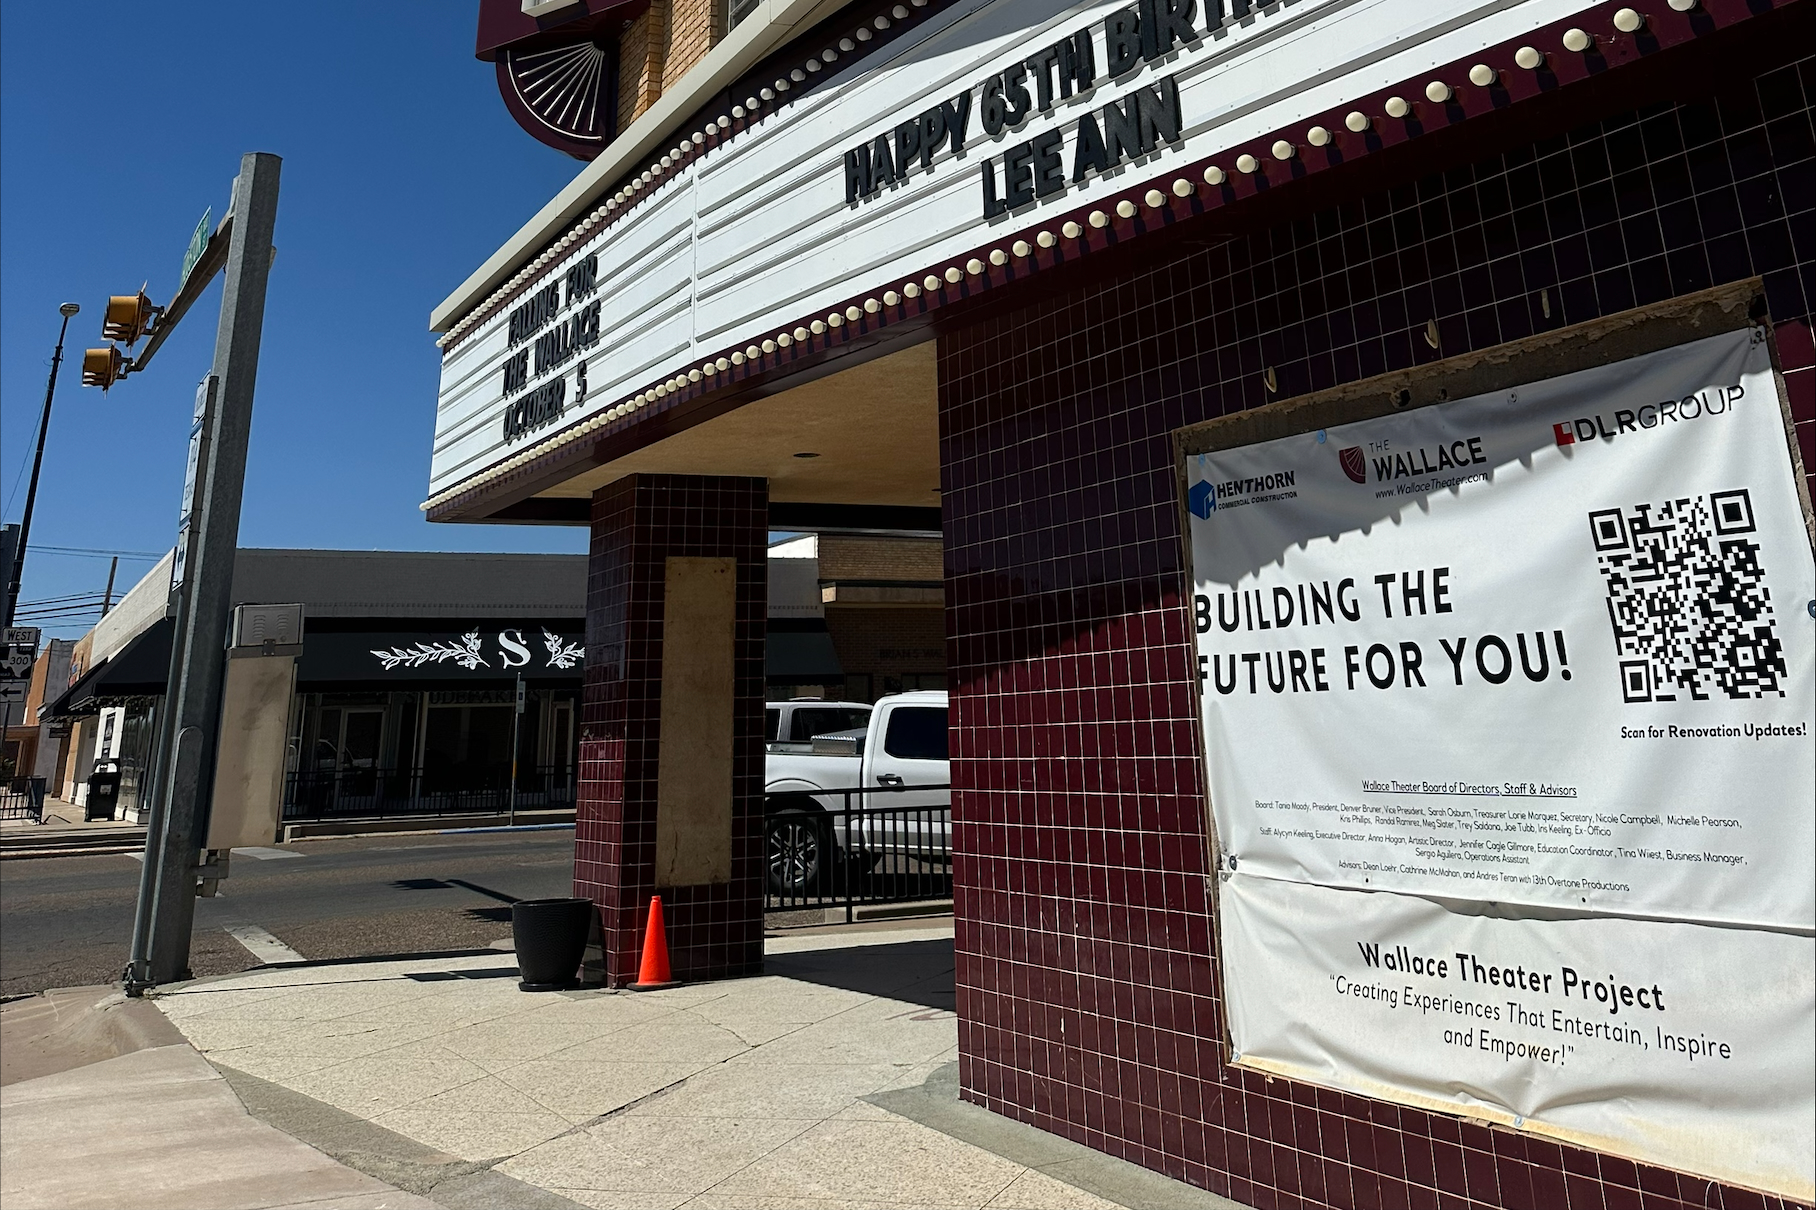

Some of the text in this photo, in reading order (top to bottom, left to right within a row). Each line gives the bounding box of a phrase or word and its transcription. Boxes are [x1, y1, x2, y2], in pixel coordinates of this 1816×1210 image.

[845, 89, 973, 203] HAPPY
[980, 27, 1096, 137] 65TH
[980, 75, 1182, 221] LEE ANN
[507, 252, 598, 347] FALLING FOR
[502, 299, 601, 396] THE WALLACE
[503, 375, 566, 440] OCTOBER
[1369, 440, 1391, 453] THE
[1372, 436, 1487, 482] WALLACE
[1216, 470, 1295, 499] HENTHORN
[1218, 491, 1298, 511] COMMERCIAL CONSTRUCTION
[1375, 471, 1489, 500] www.WallaceTheater.com
[1195, 566, 1453, 634] BUILDING THE
[7, 630, 32, 641] WEST
[498, 628, 532, 670] S
[10, 656, 29, 665] 300
[1198, 630, 1572, 696] FUTURE FOR YOU!
[1621, 722, 1807, 741] Scan for Renovation Updates!
[1361, 780, 1577, 795] Wallace Theater Board of Directors, Staff & Advisors
[1255, 800, 1274, 809] Board:
[1274, 801, 1291, 810] Tania
[1340, 803, 1362, 813] Denver
[1384, 805, 1397, 814] Vice
[1427, 807, 1446, 817] Sarah
[1473, 809, 1507, 819] Treasurer
[1508, 810, 1526, 820] Lorie
[1527, 811, 1560, 822] Marquez,
[1560, 812, 1595, 825] Secretary,
[1595, 814, 1618, 823] Nicole
[1619, 813, 1663, 827] Campbell,
[1667, 815, 1700, 826] Michelle
[1701, 816, 1742, 828] Pearson,
[1339, 814, 1351, 823] Kris
[1396, 817, 1422, 827] Ramirez,
[1422, 819, 1436, 830] Meg
[1457, 820, 1473, 832] Trey
[1473, 821, 1503, 832] Saldana,
[1504, 822, 1517, 832] Joe
[1517, 823, 1537, 833] Tubb,
[1549, 824, 1574, 836] Keeling,
[1273, 828, 1293, 839] Alycyn
[1315, 830, 1341, 840] Executive
[1341, 832, 1367, 842] Director,
[1367, 833, 1383, 843] Anna
[1384, 834, 1407, 846] Hogan,
[1408, 835, 1429, 845] Artistic
[1429, 837, 1457, 848] Director,
[1459, 838, 1484, 849] Jennifer
[1485, 840, 1506, 852] Cagle
[1537, 843, 1569, 854] Education
[1569, 844, 1617, 858] Coordinator,
[1617, 847, 1636, 858] Tina
[1666, 849, 1701, 862] Business
[1703, 851, 1748, 866] Manager,
[1415, 848, 1436, 859] Sergio
[1436, 849, 1463, 861] Aguilera,
[1464, 851, 1501, 863] Operations
[1363, 861, 1379, 871] Dean
[1400, 864, 1428, 876] Cathrine
[1428, 867, 1462, 879] McMahan,
[1462, 870, 1475, 880] and
[1476, 870, 1499, 881] Andres
[1499, 872, 1518, 883] Teran
[1518, 874, 1531, 884] with
[1532, 874, 1546, 885] 13th
[1547, 875, 1581, 888] Overtone
[1581, 878, 1630, 892] Productions
[1357, 940, 1666, 1015] Wallace Theater Project
[1329, 974, 1732, 1061] “Creating Experiences That Entertain, Inspire
[1443, 1026, 1576, 1067] and Empower!”
